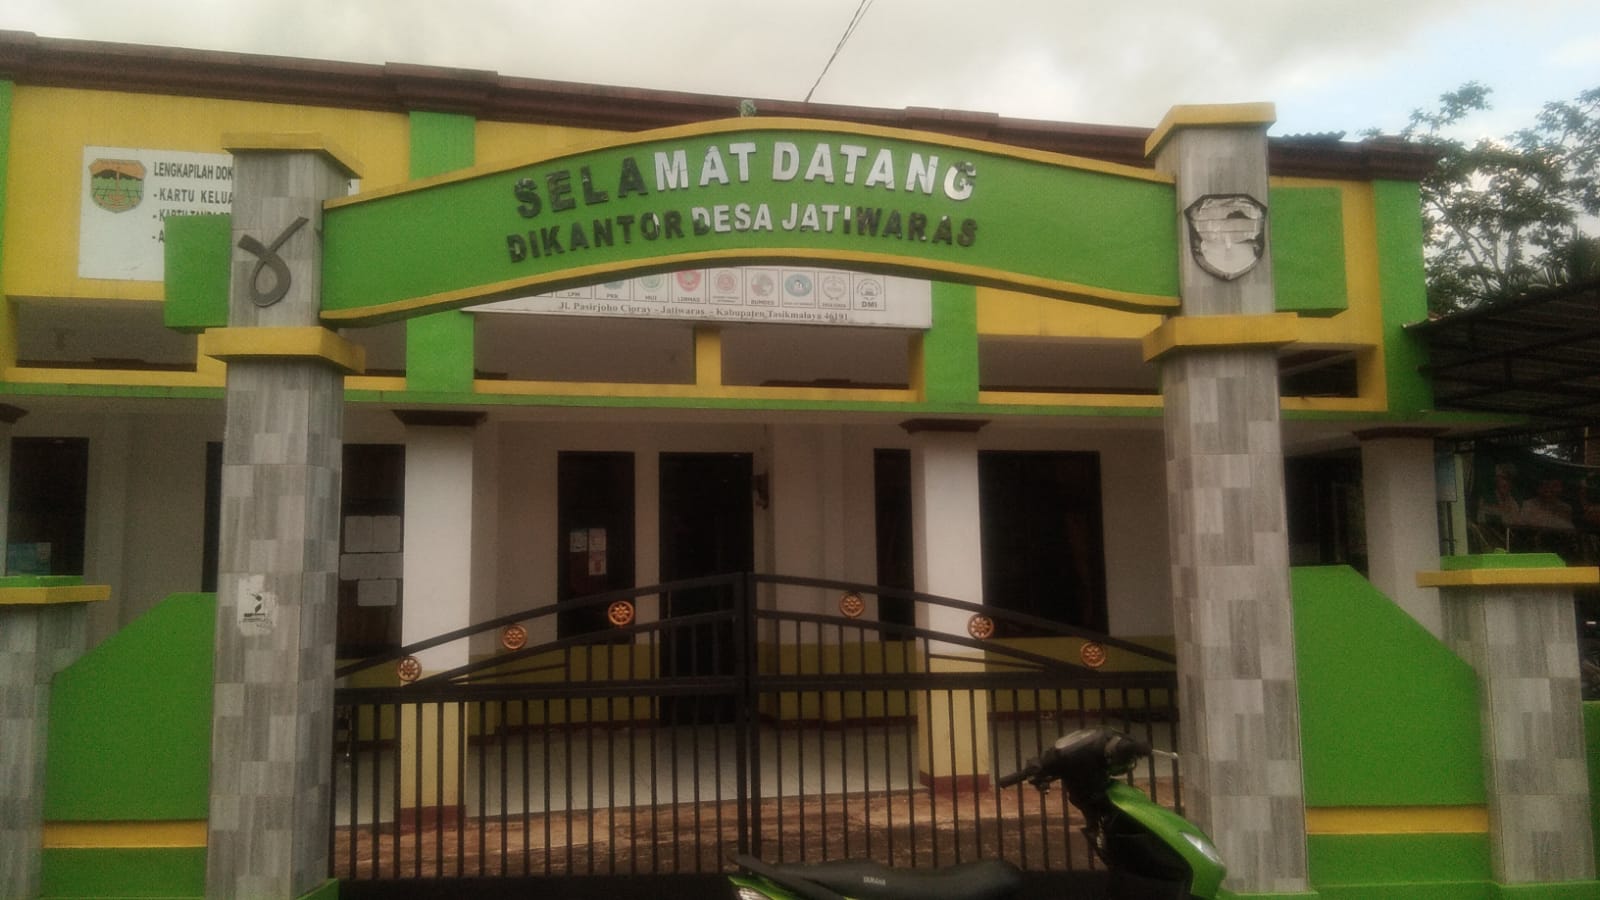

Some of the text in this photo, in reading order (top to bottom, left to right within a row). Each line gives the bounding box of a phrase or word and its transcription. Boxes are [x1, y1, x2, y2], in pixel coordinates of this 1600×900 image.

[154, 161, 214, 180] LENGKAPILAH
[513, 141, 977, 219] SELAMAT DATANG
[159, 187, 195, 203] KARTU
[691, 202, 774, 237] DESA
[781, 202, 978, 248] JATIWARAS
